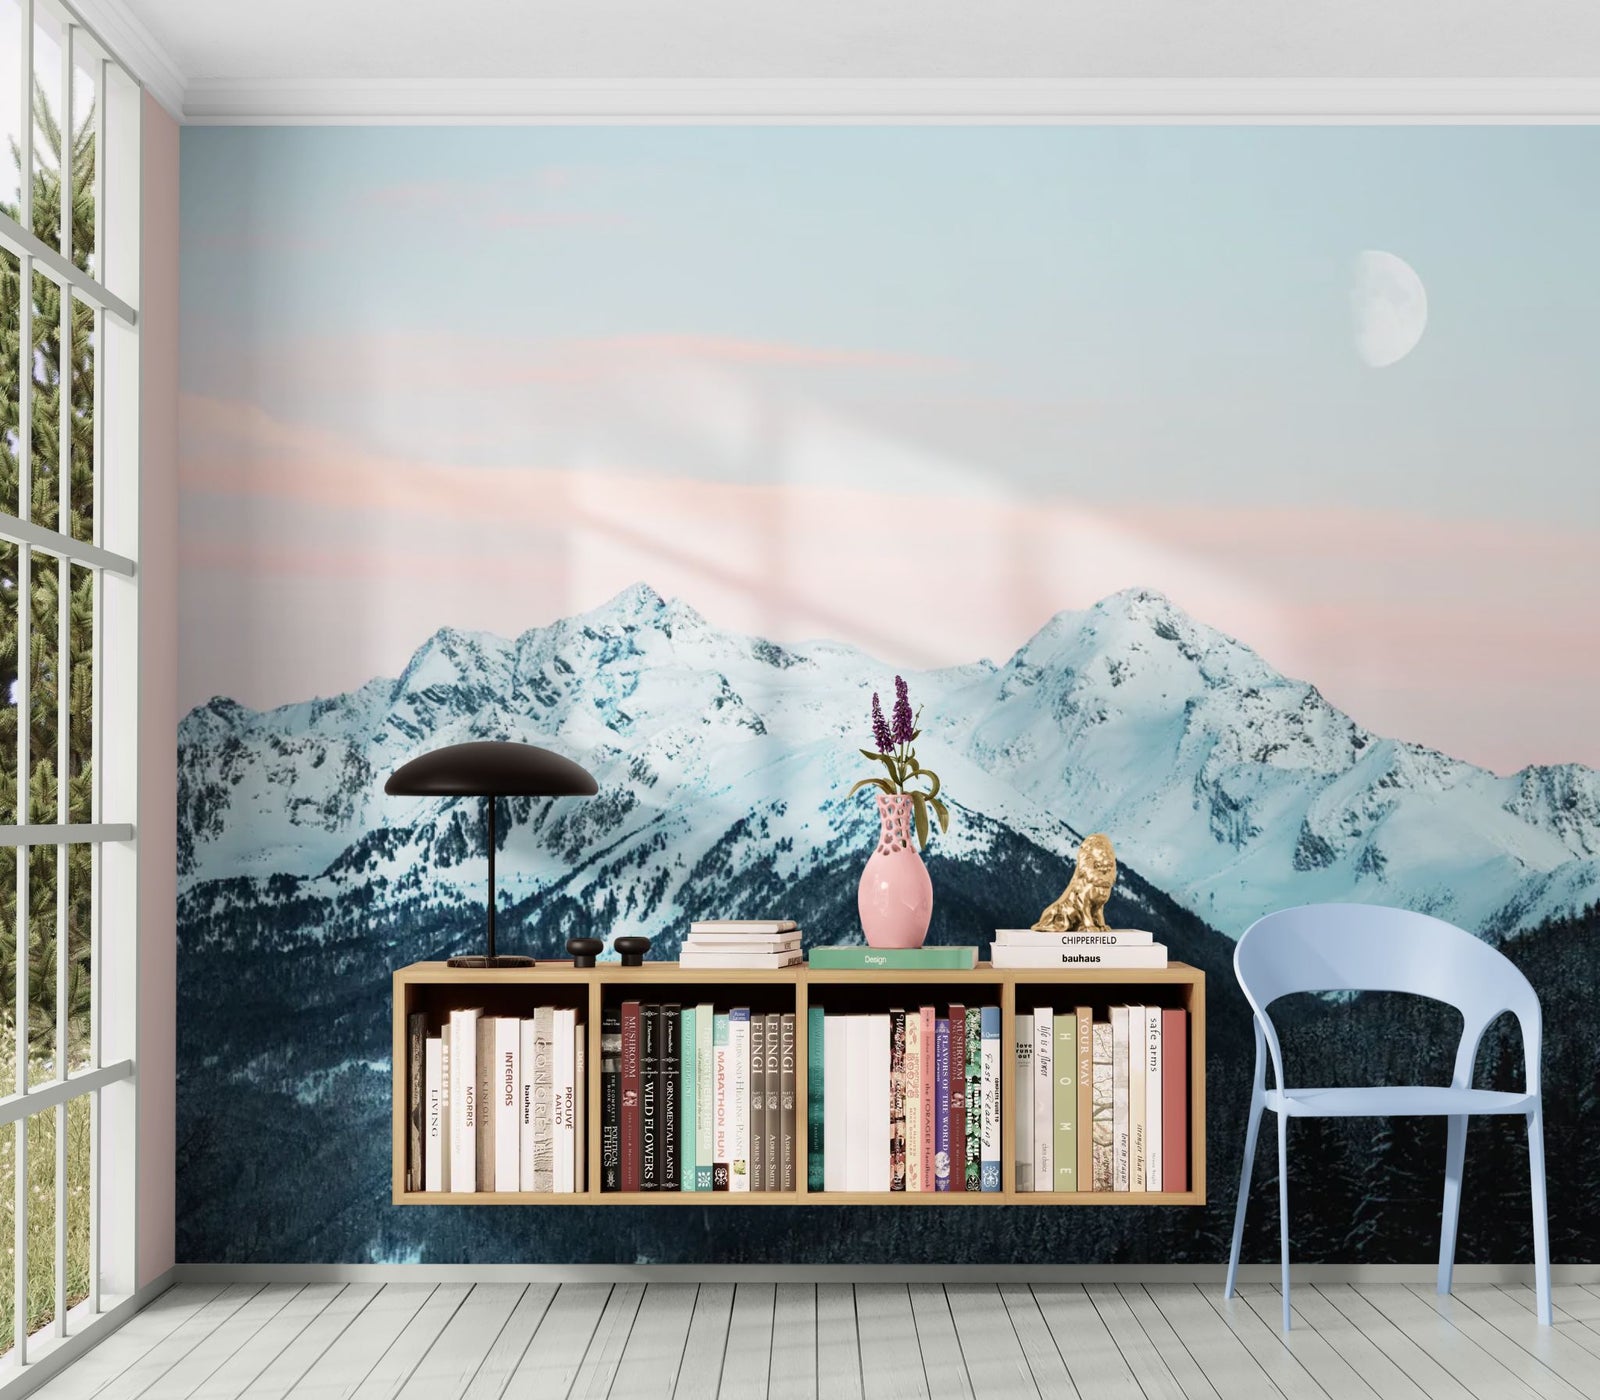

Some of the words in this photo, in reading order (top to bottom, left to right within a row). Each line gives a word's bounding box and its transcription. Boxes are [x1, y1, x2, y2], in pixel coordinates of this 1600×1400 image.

[1061, 936, 1117, 945] CHIPPERFIELD
[864, 955, 887, 965] Design
[1062, 954, 1101, 963] bauhaus
[1037, 1025, 1051, 1037] life
[1080, 1017, 1090, 1055] YOUR
[1150, 1017, 1161, 1040] safe
[628, 1016, 637, 1078] MUSHROOM
[752, 1021, 763, 1075] FUNGI
[767, 1021, 778, 1075] FUNGI
[782, 1021, 793, 1075] FUNGI
[1150, 1044, 1158, 1072] arms
[504, 1051, 514, 1107] INTERIORS
[985, 1053, 993, 1082] Fast
[1037, 1055, 1051, 1077] flower
[1080, 1059, 1090, 1087] WAY
[644, 1081, 654, 1116] WILD
[717, 1051, 726, 1128] MARATHON
[942, 1079, 949, 1090] OF
[431, 1089, 439, 1138] LIVING
[465, 1086, 474, 1128] MORRIS
[482, 1081, 490, 1127] KINFOLK
[555, 1093, 563, 1126] AALTO
[666, 1080, 674, 1142] ORNAMENTAL
[982, 1090, 994, 1148] Reading
[1059, 1033, 1071, 1174] HOME
[603, 1126, 612, 1167] ETHICS
[644, 1118, 654, 1179] FLOWERS
[717, 1131, 726, 1158] RUN
[1134, 1123, 1143, 1153] stronger
[666, 1144, 674, 1179] PLANTS
[754, 1164, 762, 1188] SMITH
[769, 1164, 777, 1188] SMITH
[784, 1164, 792, 1188] SMITH
[1137, 1155, 1145, 1172] than
